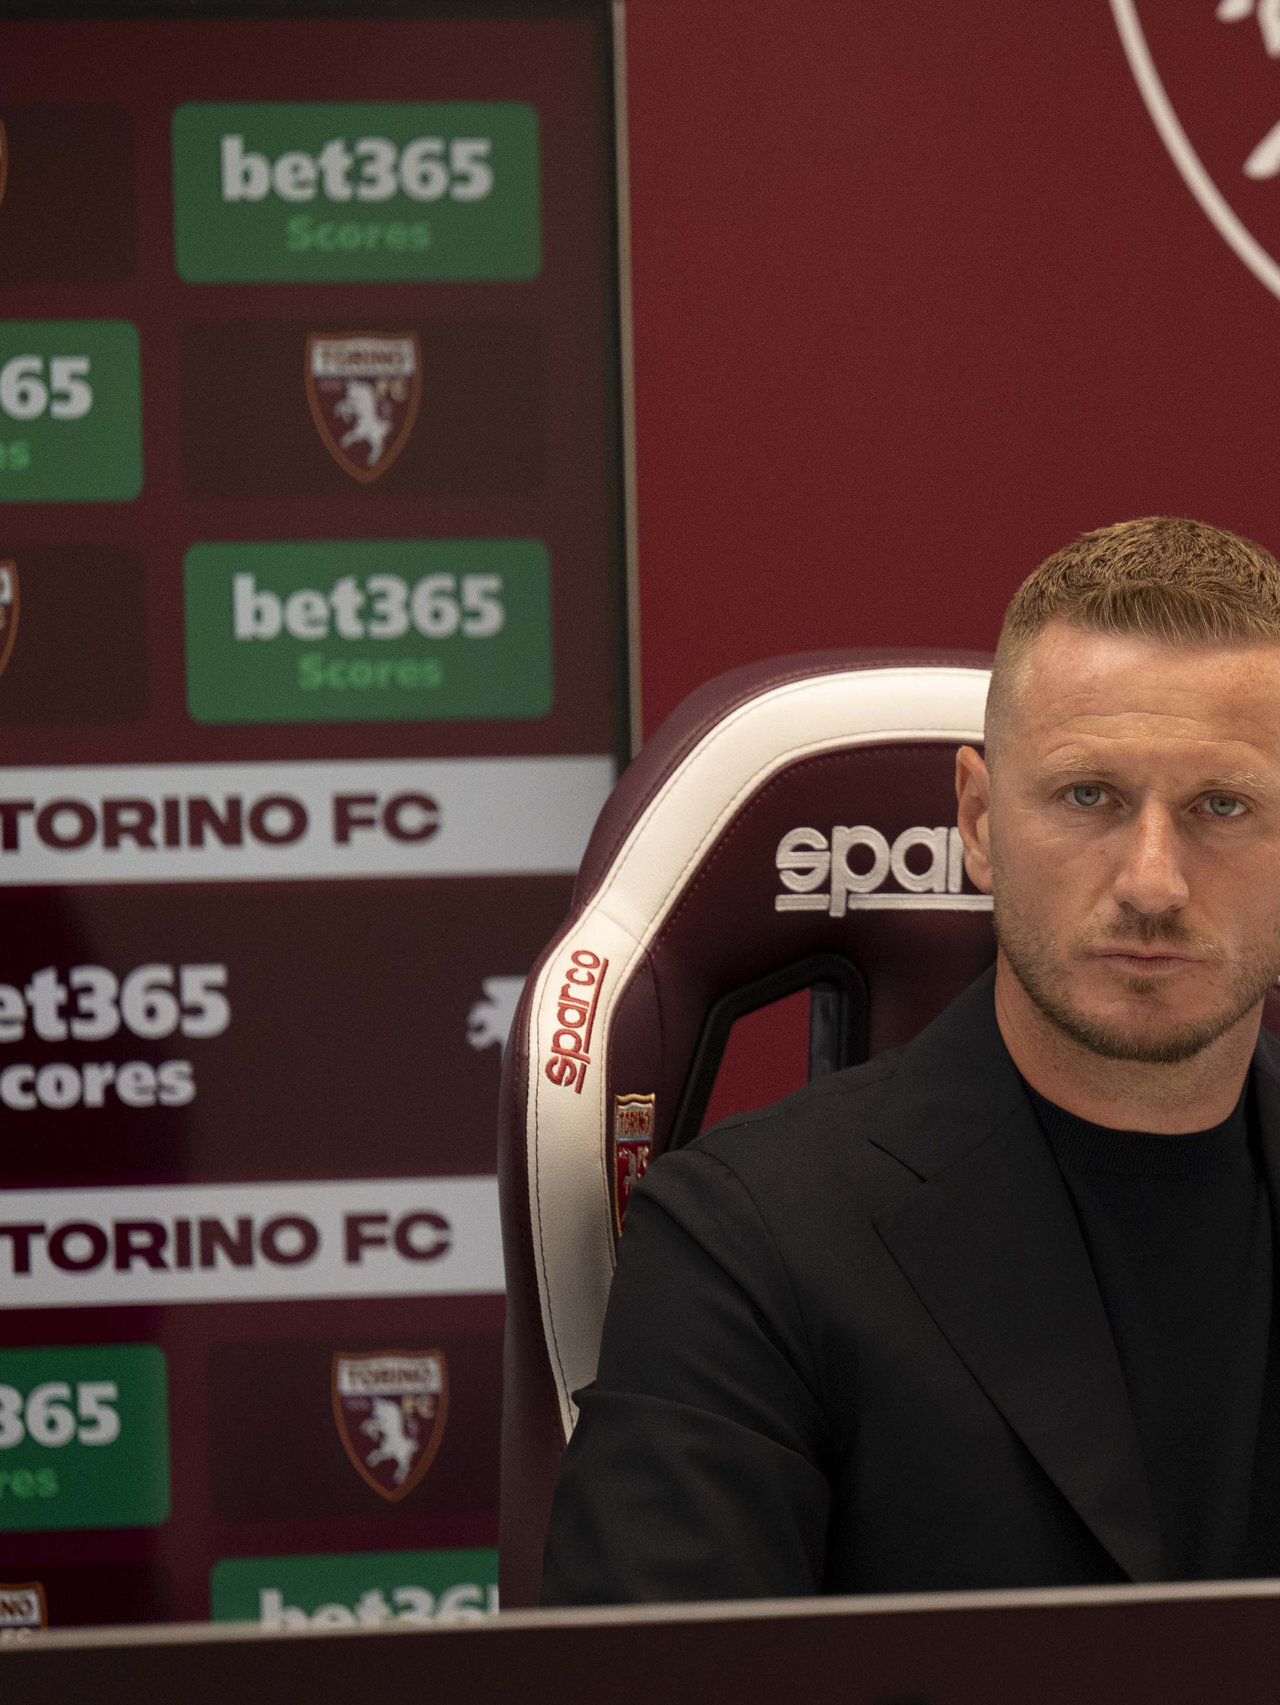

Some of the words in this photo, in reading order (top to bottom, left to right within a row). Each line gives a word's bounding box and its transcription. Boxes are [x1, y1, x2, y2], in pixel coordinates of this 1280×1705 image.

[220, 134, 494, 202] bet365
[287, 217, 432, 252] Scores
[0, 355, 93, 420] 65
[232, 572, 505, 640] bet365
[298, 655, 443, 690] Scores
[0, 792, 310, 852] TORINO
[332, 788, 442, 846] FC
[775, 824, 964, 917] spar
[545, 949, 607, 1093] sparco
[0, 1059, 196, 1110] cores
[2, 1214, 321, 1275] TORINO
[341, 1209, 453, 1266] FC
[258, 1584, 499, 1630] bt36
